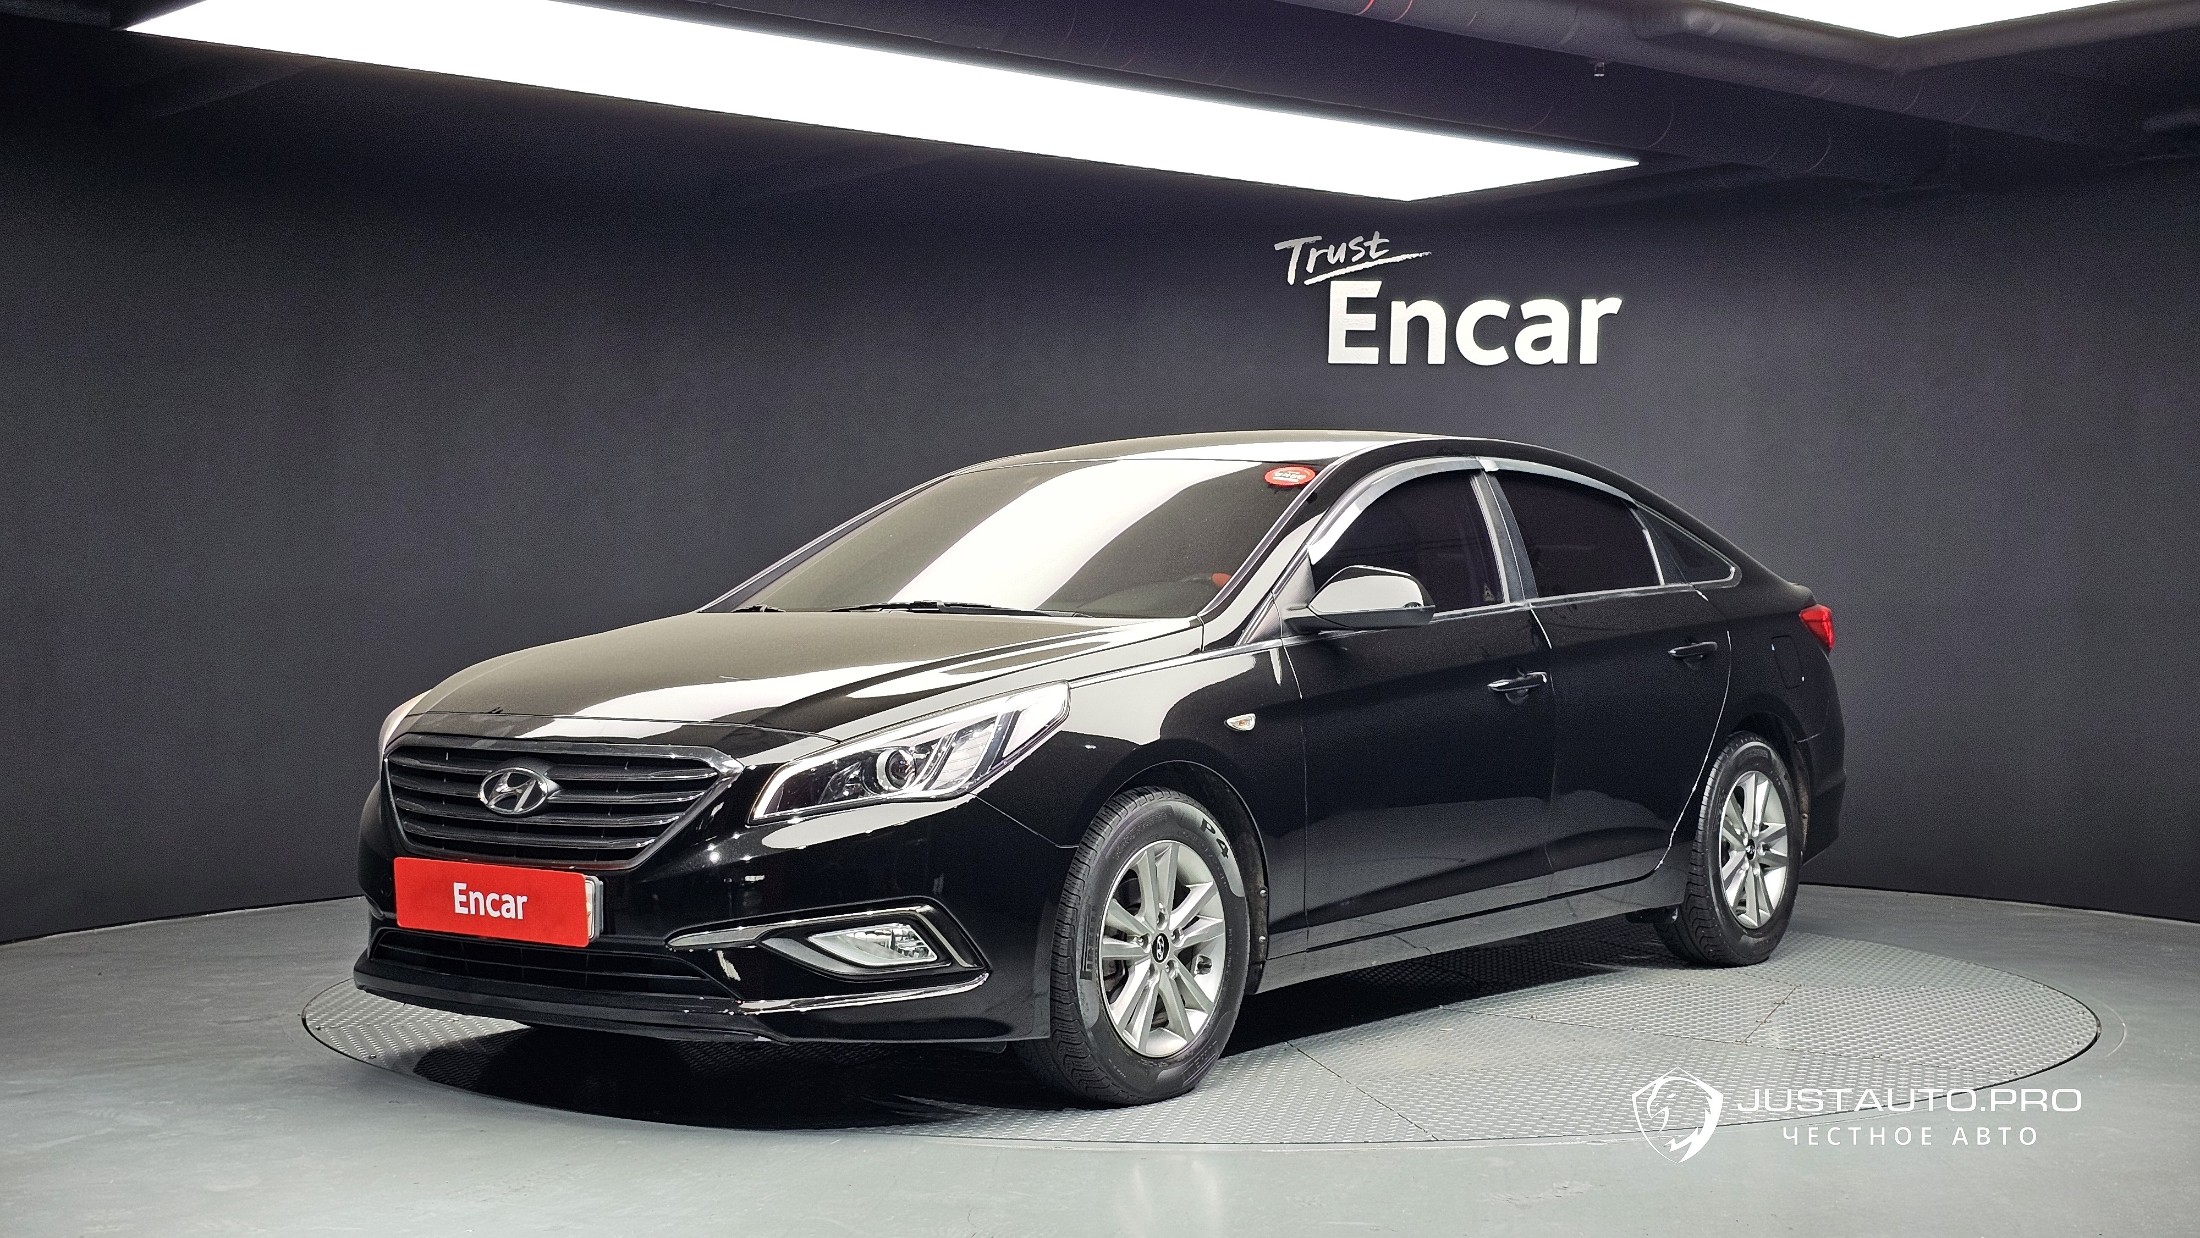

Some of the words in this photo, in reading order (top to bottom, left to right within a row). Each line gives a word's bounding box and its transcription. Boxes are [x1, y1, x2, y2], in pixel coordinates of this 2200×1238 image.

[1274, 231, 1390, 285] Trust
[1327, 280, 1623, 366] Encar
[453, 882, 528, 920] Encar
